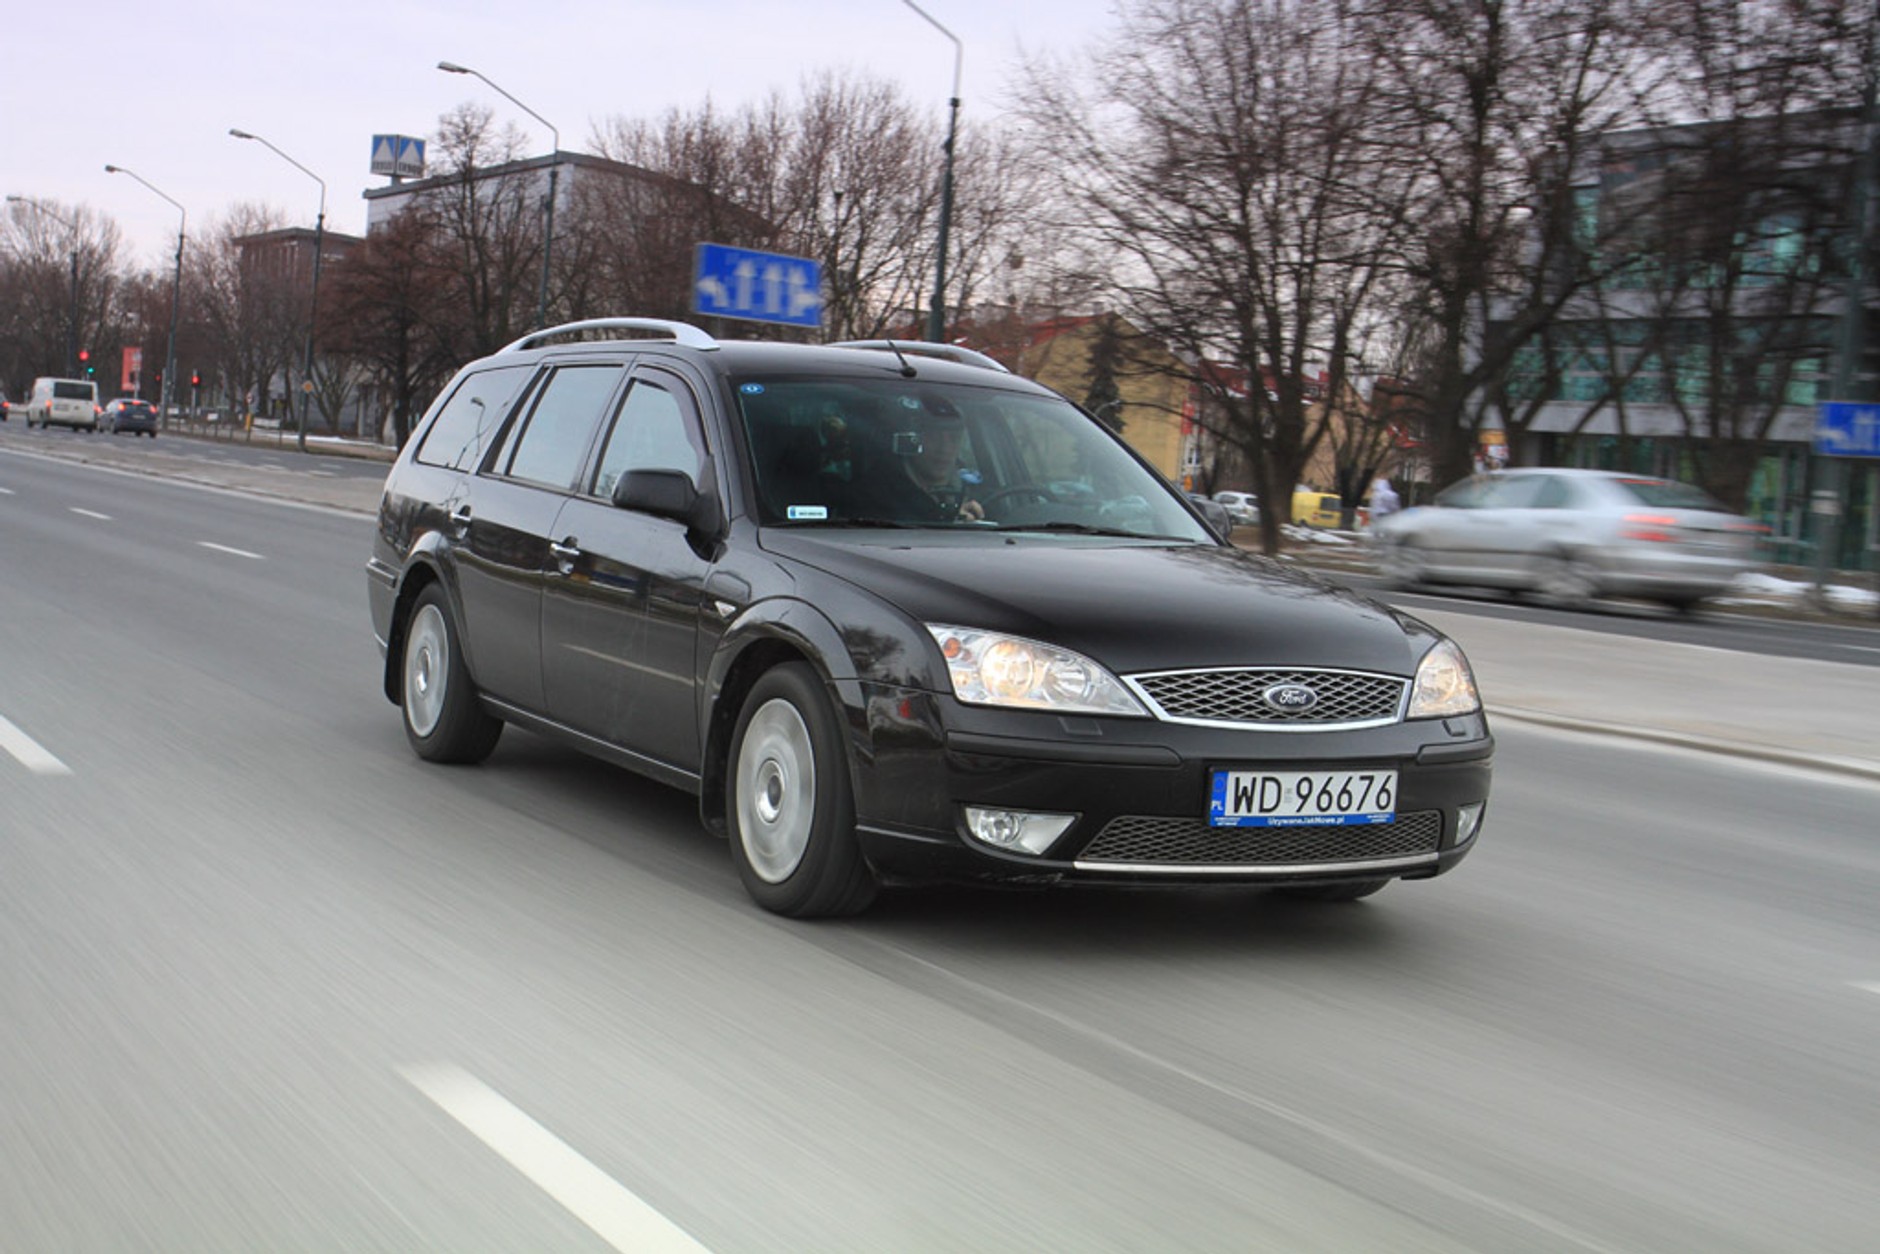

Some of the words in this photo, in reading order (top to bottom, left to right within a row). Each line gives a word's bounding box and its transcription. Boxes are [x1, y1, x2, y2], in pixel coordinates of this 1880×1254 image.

[1280, 689, 1307, 704] Ford
[1233, 776, 1282, 813] WD
[1296, 775, 1392, 812] 96676
[1211, 800, 1223, 811] PL
